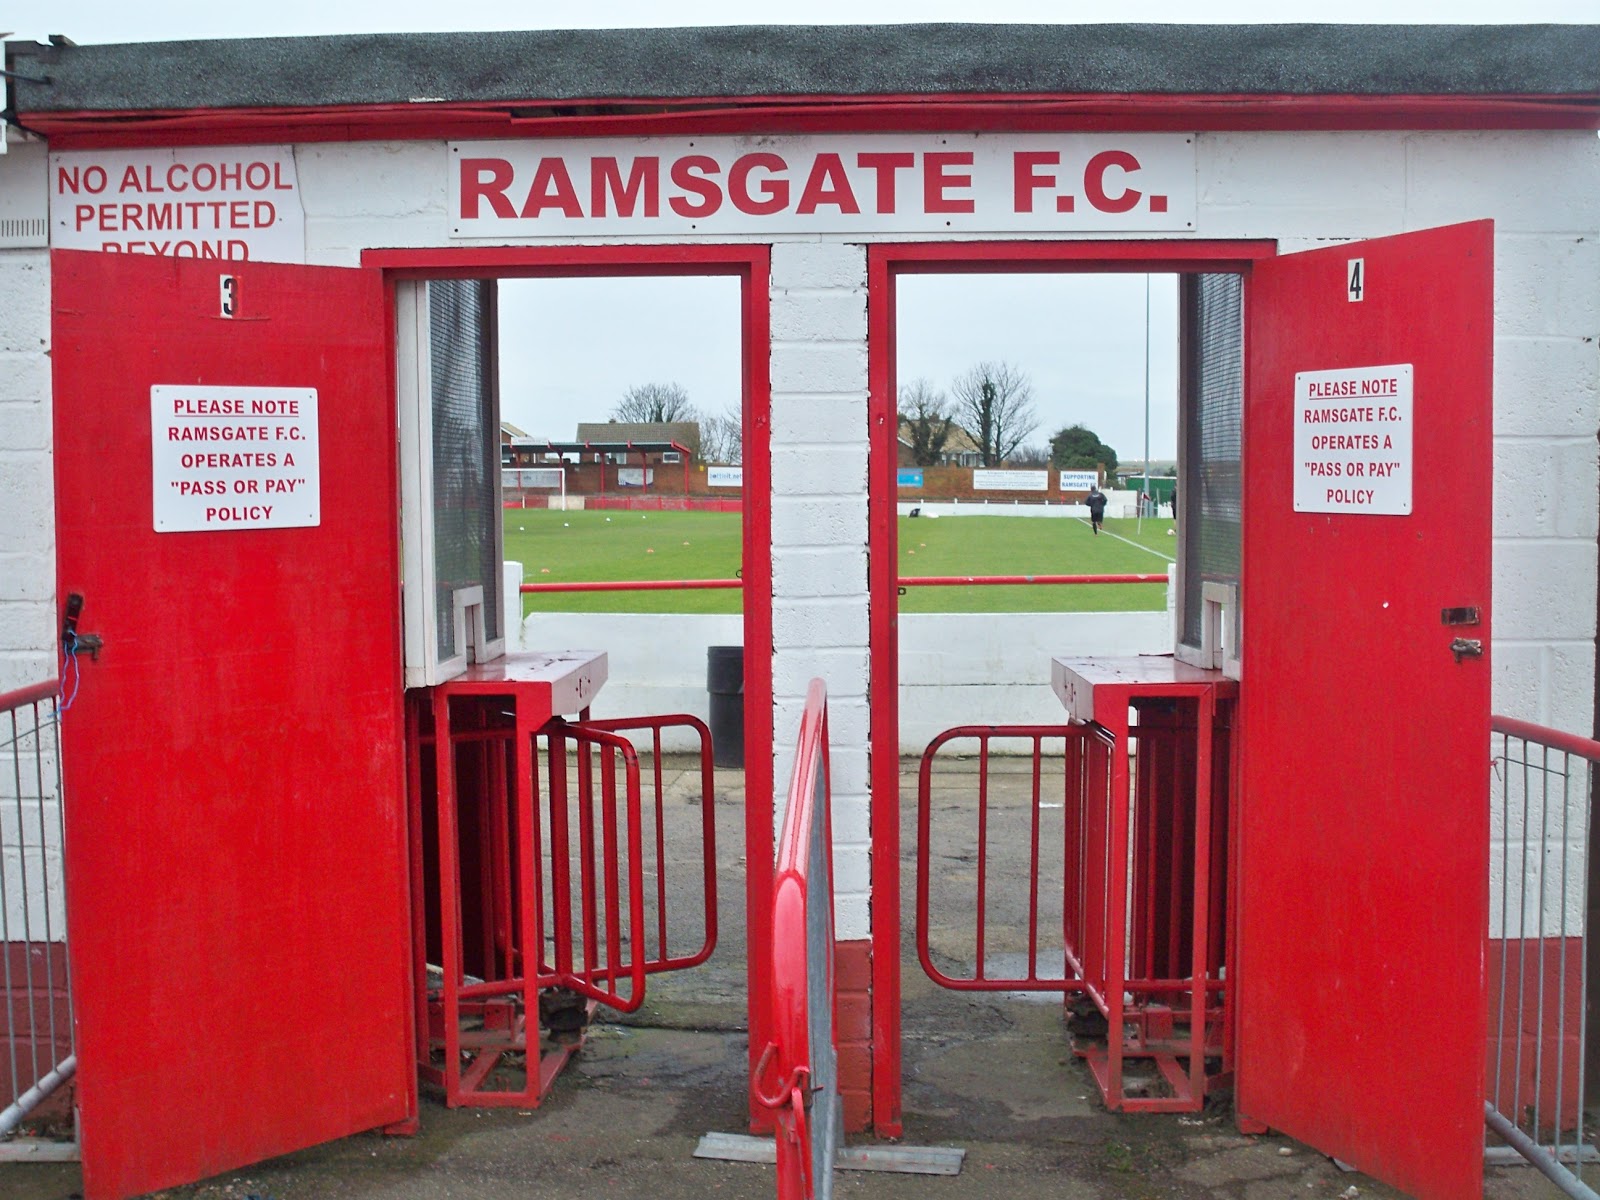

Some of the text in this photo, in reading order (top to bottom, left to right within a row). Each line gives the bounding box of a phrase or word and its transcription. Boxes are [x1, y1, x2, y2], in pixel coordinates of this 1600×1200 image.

[58, 162, 292, 194] NO ALCOHOL
[460, 150, 1167, 219] RAMSGATE F.C.
[76, 201, 275, 231] PERMITTED
[1350, 262, 1361, 299] 4
[223, 278, 239, 315] 3
[1309, 379, 1397, 396] PLEASE NOTE
[174, 400, 299, 414] PLEASE NOTE
[1305, 407, 1401, 423] RAMSGATE F.C.
[169, 427, 305, 440] RAMSGATE F.C.
[1312, 435, 1392, 449] OPERATES A
[182, 453, 294, 468] OPERATES A
[1305, 463, 1399, 476] "PASS OR PAY"
[171, 479, 305, 495] "PASS OR PAY"
[1327, 489, 1373, 504] POLICY
[207, 506, 272, 521] POLICY
